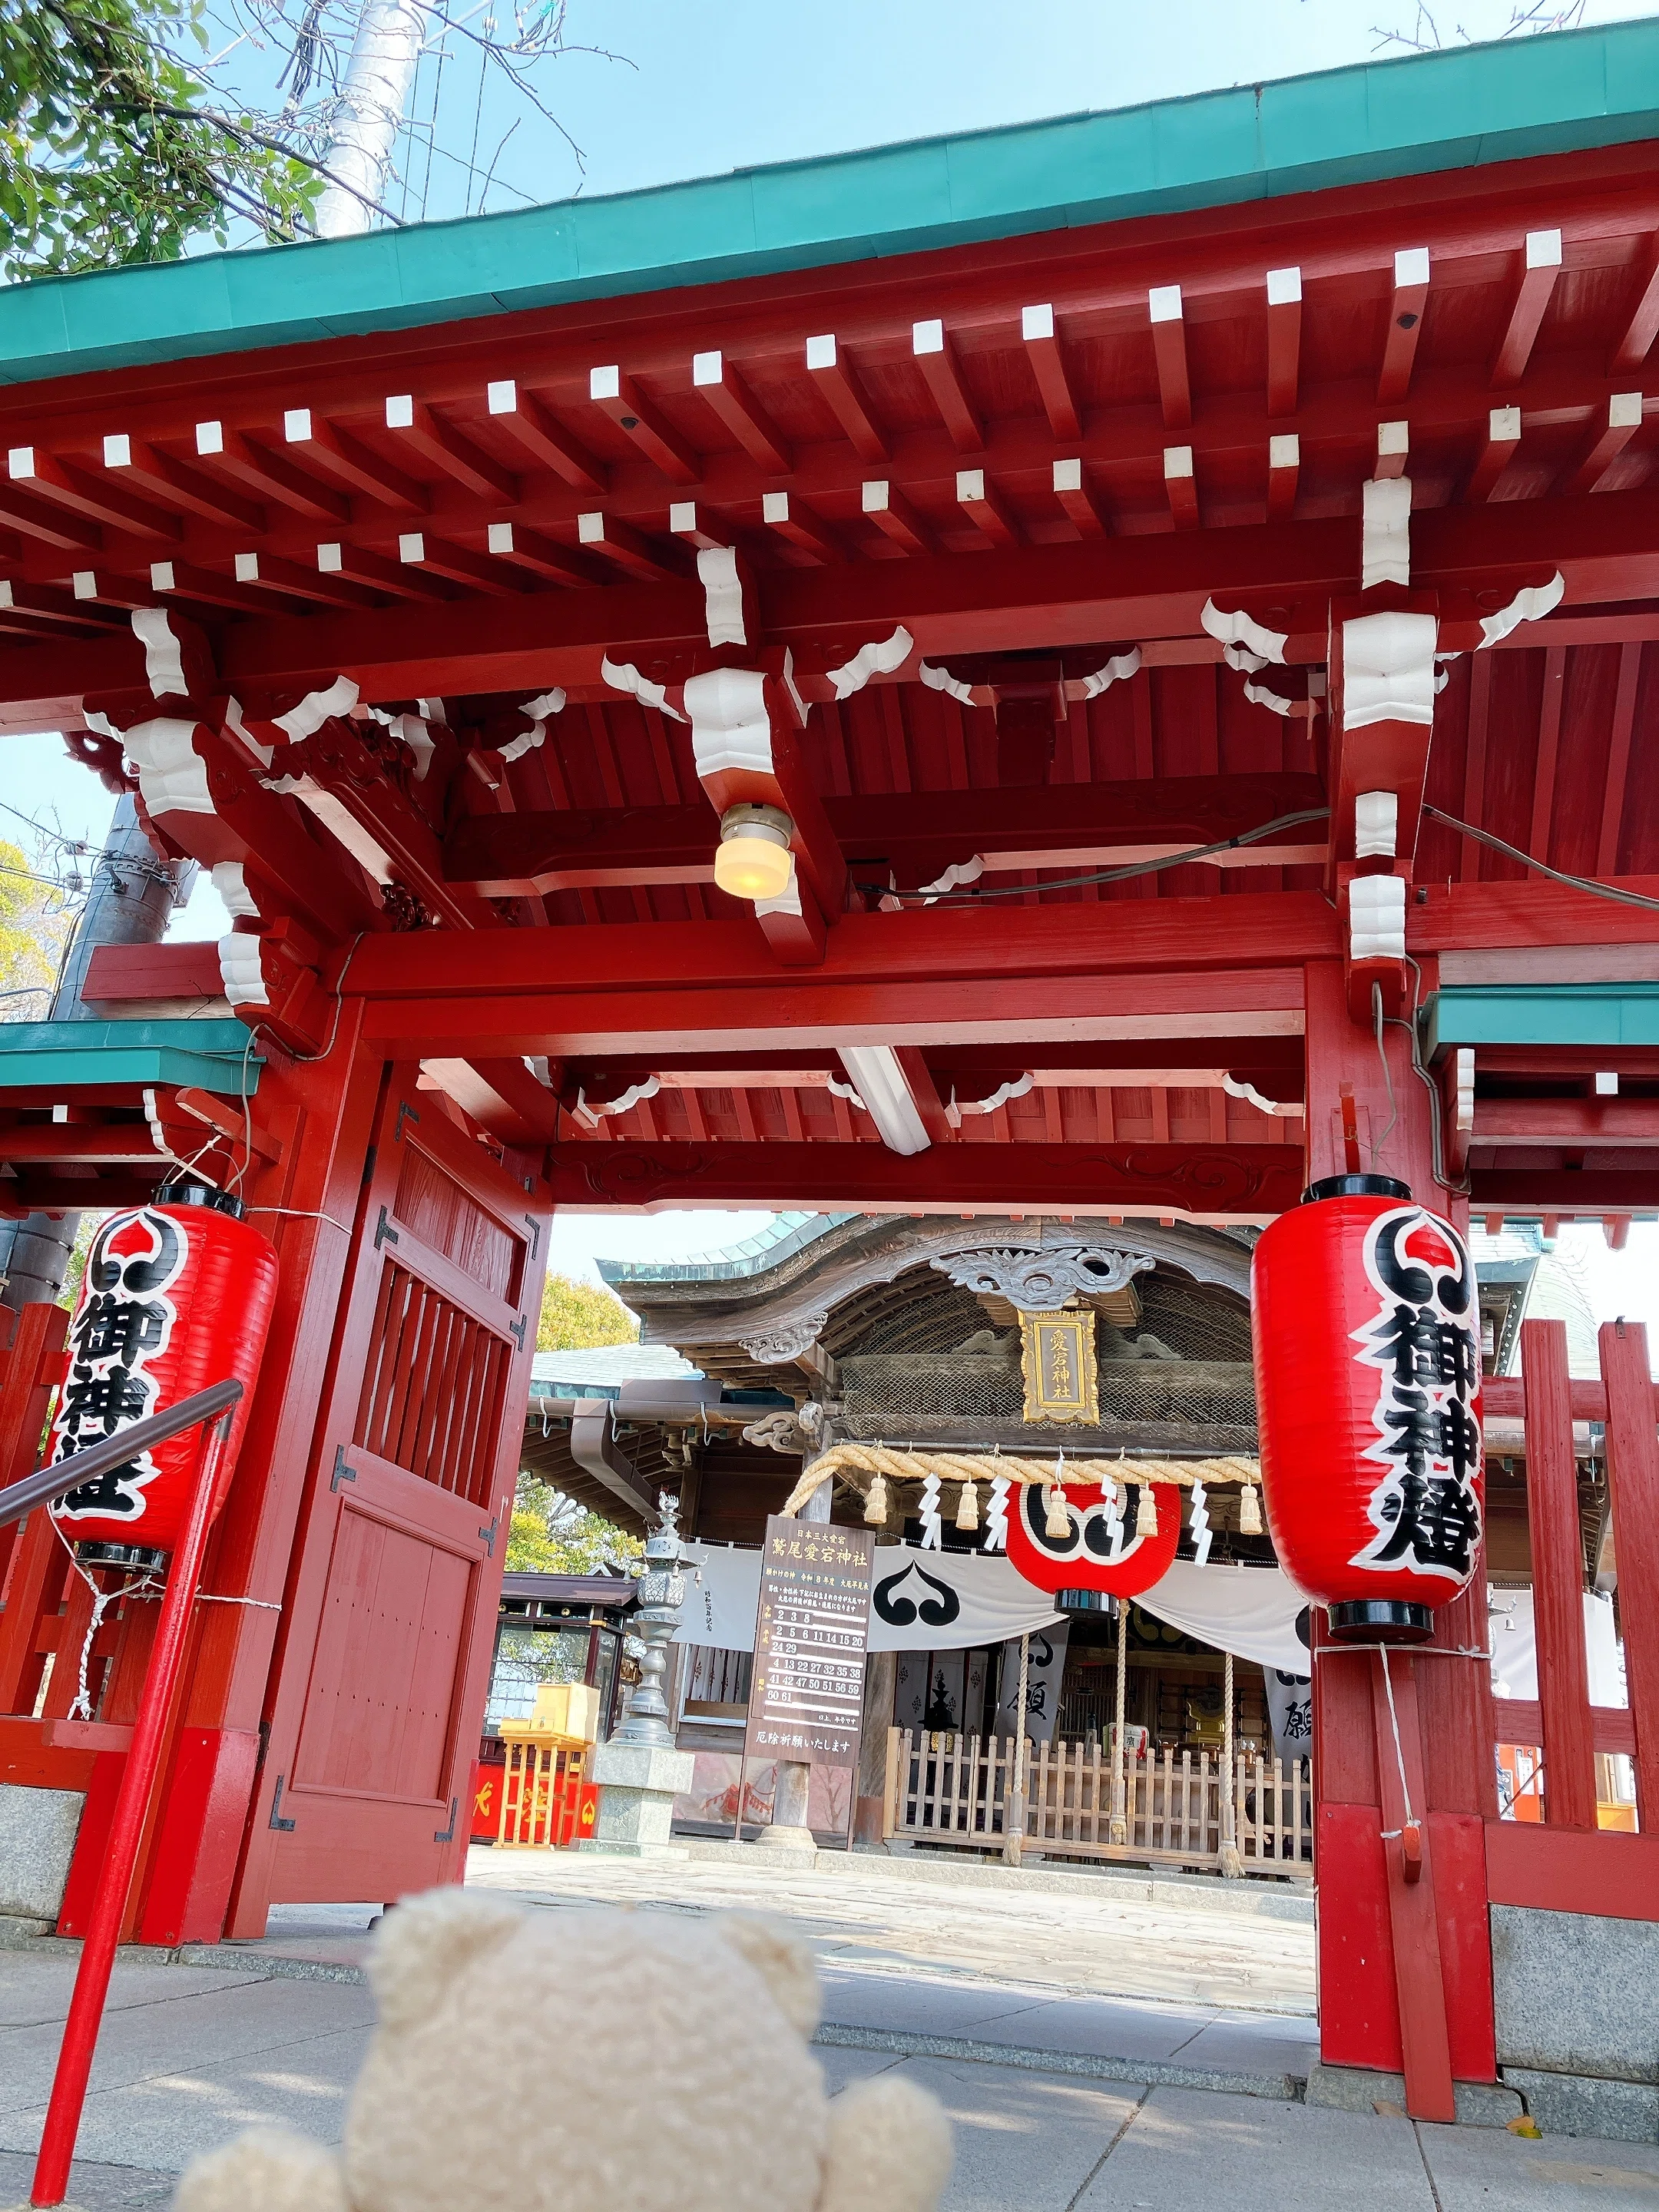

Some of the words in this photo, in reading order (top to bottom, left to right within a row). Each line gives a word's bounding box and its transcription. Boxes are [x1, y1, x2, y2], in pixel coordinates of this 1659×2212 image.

[1050, 1330, 1071, 1399] 愛宕神社
[1369, 1303, 1481, 1575] 御神燈
[797, 1529, 846, 1545] 日本三大愛宕
[772, 1537, 868, 1567] 鷲尾愛宕神社
[766, 1568, 796, 1580] 願かけの神
[840, 1579, 869, 1591] 大厄早見表
[704, 1591, 713, 1632] 昭和百年記念
[778, 1610, 784, 1620] 2
[791, 1612, 797, 1621] 3
[803, 1614, 810, 1623] 8
[777, 1626, 783, 1635] 2
[790, 1628, 796, 1637] 5
[803, 1630, 809, 1639] 6
[813, 1631, 823, 1641] 11
[826, 1633, 836, 1644] 14
[839, 1634, 849, 1645] 15
[852, 1637, 863, 1647] 20
[773, 1642, 783, 1652] 24
[786, 1644, 797, 1654] 29
[773, 1658, 780, 1667] 4
[784, 1660, 795, 1669] 13
[797, 1661, 808, 1671] 22
[810, 1663, 821, 1674] 27
[823, 1664, 834, 1675] 32
[837, 1667, 848, 1677] 35
[849, 1668, 861, 1678] 38
[770, 1674, 780, 1684] 41
[783, 1676, 794, 1685] 42
[796, 1677, 807, 1687] 47
[809, 1679, 820, 1689] 50
[823, 1681, 833, 1691] 51
[835, 1683, 846, 1693] 56
[848, 1684, 859, 1694] 59
[768, 1690, 779, 1700] 60
[781, 1692, 792, 1702] 61
[756, 1731, 850, 1753] 厄除祈願いたします
